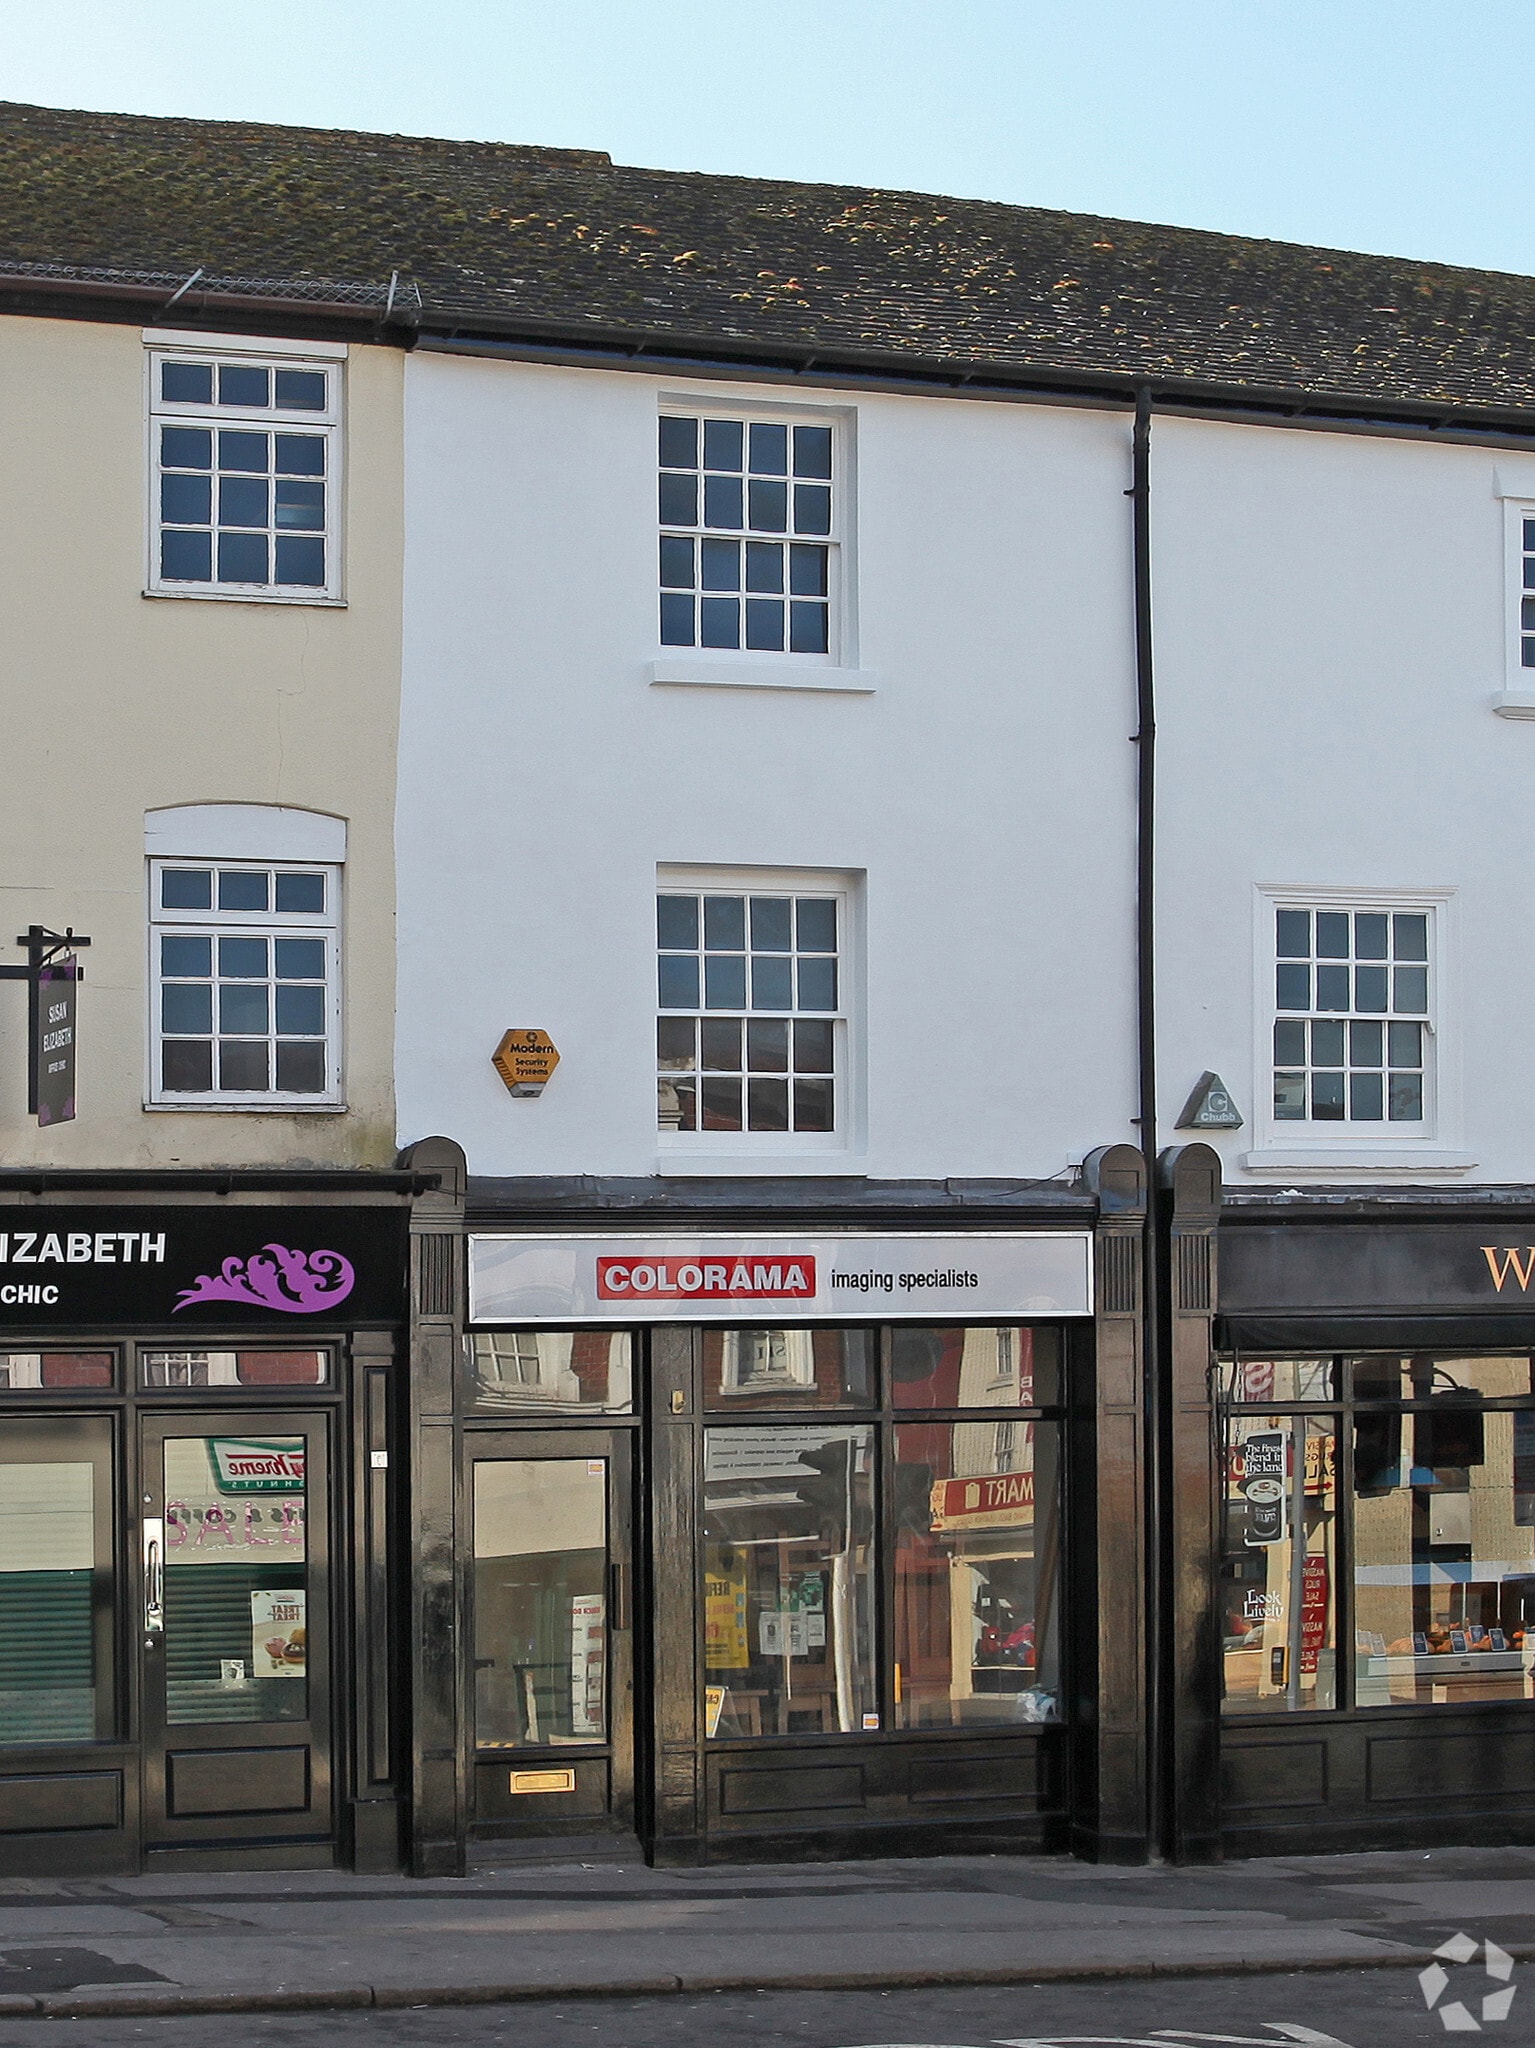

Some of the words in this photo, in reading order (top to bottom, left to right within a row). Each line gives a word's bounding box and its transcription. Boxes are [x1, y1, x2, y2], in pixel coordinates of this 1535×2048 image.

[48, 1001, 68, 1024] SUSAN
[43, 1027, 72, 1053] ELIZABETH
[510, 1043, 554, 1053] Modern
[515, 1057, 549, 1067] Security
[515, 1067, 549, 1076] Systems
[1200, 1112, 1236, 1121] Chubb
[604, 1264, 808, 1292] COLORAMA
[831, 1269, 893, 1292] imaging
[898, 1269, 979, 1292] specialists
[0, 1284, 59, 1305] CHIC
[1246, 1589, 1282, 1605] Look
[1243, 1601, 1284, 1618] Lively
